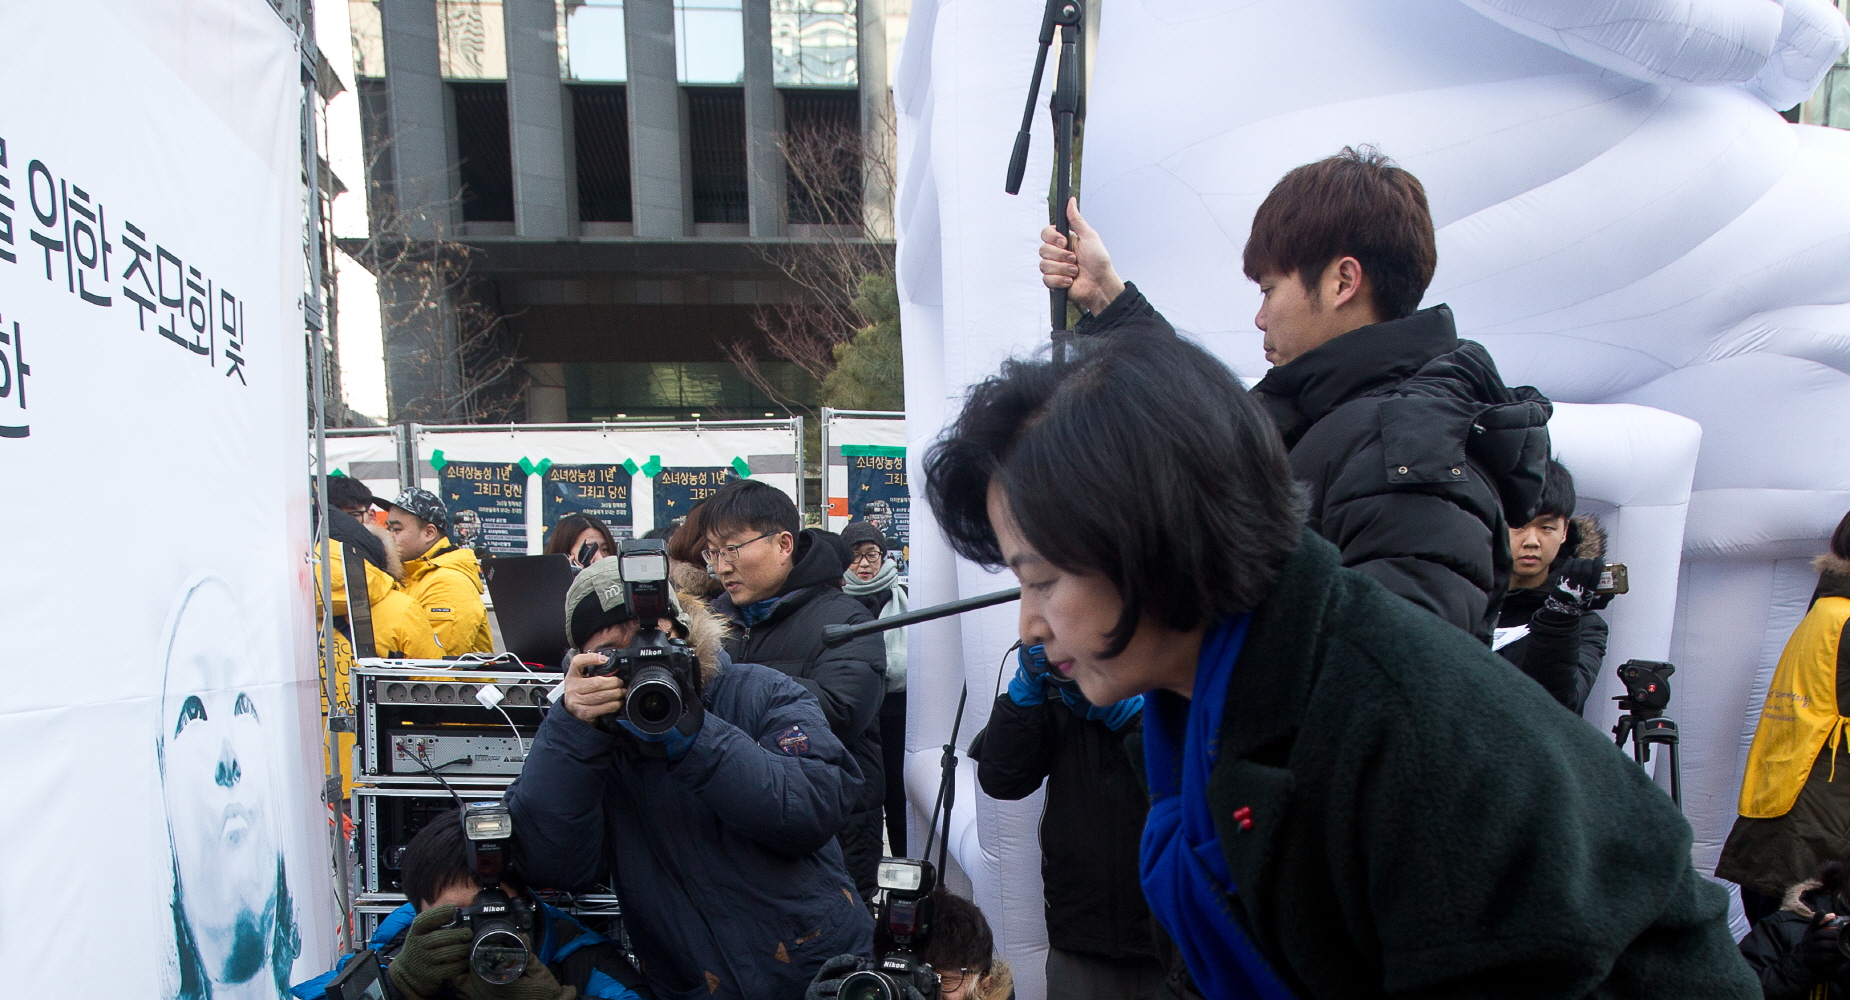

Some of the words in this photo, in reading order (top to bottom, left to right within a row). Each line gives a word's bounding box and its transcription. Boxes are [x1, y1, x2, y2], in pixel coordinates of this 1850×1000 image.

[28, 159, 112, 307] 위한
[122, 220, 215, 367] 추모회
[220, 288, 247, 387] 및
[857, 456, 903, 470] 소녀상농성
[447, 466, 492, 480] 소녀상농성
[496, 466, 510, 481] 1년
[550, 469, 596, 483] 소녀상농성
[600, 468, 614, 483] 1년
[662, 471, 707, 486] 소녀상농성
[711, 470, 725, 485] 1년
[473, 482, 501, 496] 그리고
[503, 484, 522, 498] 당신
[577, 485, 605, 499] 그리고
[608, 485, 626, 499] 당신
[883, 961, 906, 969] Nikon
